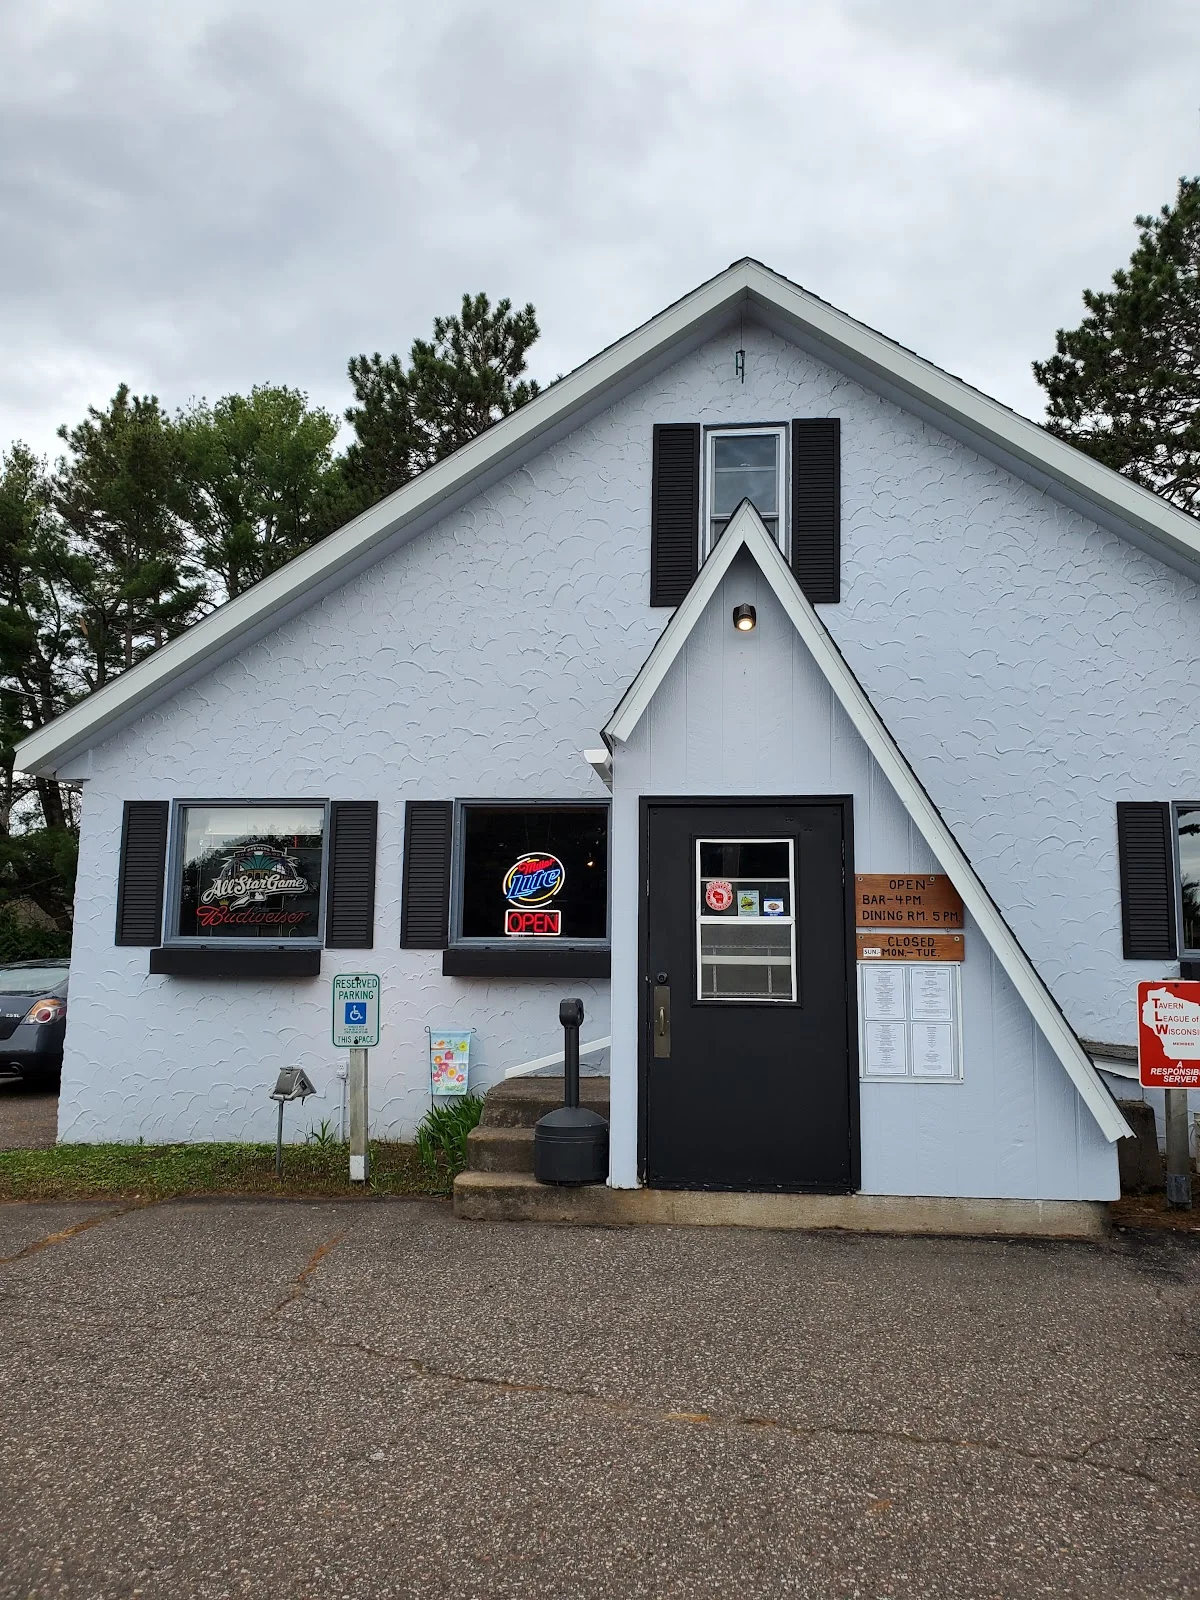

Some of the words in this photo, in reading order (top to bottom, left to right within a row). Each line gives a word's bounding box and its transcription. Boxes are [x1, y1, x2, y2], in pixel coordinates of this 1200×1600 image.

[517, 858, 555, 875] Miller
[201, 878, 234, 904] All
[235, 874, 266, 894] Star
[266, 873, 305, 890] Game
[506, 868, 561, 899] Lite
[196, 905, 311, 927] Budweiser
[862, 910, 903, 921] DINING
[907, 911, 928, 921] RM.
[508, 912, 559, 933] OPEN
[887, 936, 935, 947] CLOSED
[335, 978, 378, 989] RESERVED
[338, 990, 374, 1000] PARKING
[1152, 998, 1184, 1010] TAVERN
[1154, 1011, 1190, 1023] LEAGUE
[1191, 1015, 1199, 1023] of
[1155, 1024, 1200, 1036] WISCONSI
[337, 1036, 352, 1044] THIS
[354, 1035, 374, 1044] SPACE
[1176, 1060, 1183, 1068] A
[1150, 1067, 1200, 1076] RESPONSIB
[1163, 1075, 1198, 1083] SERVER
